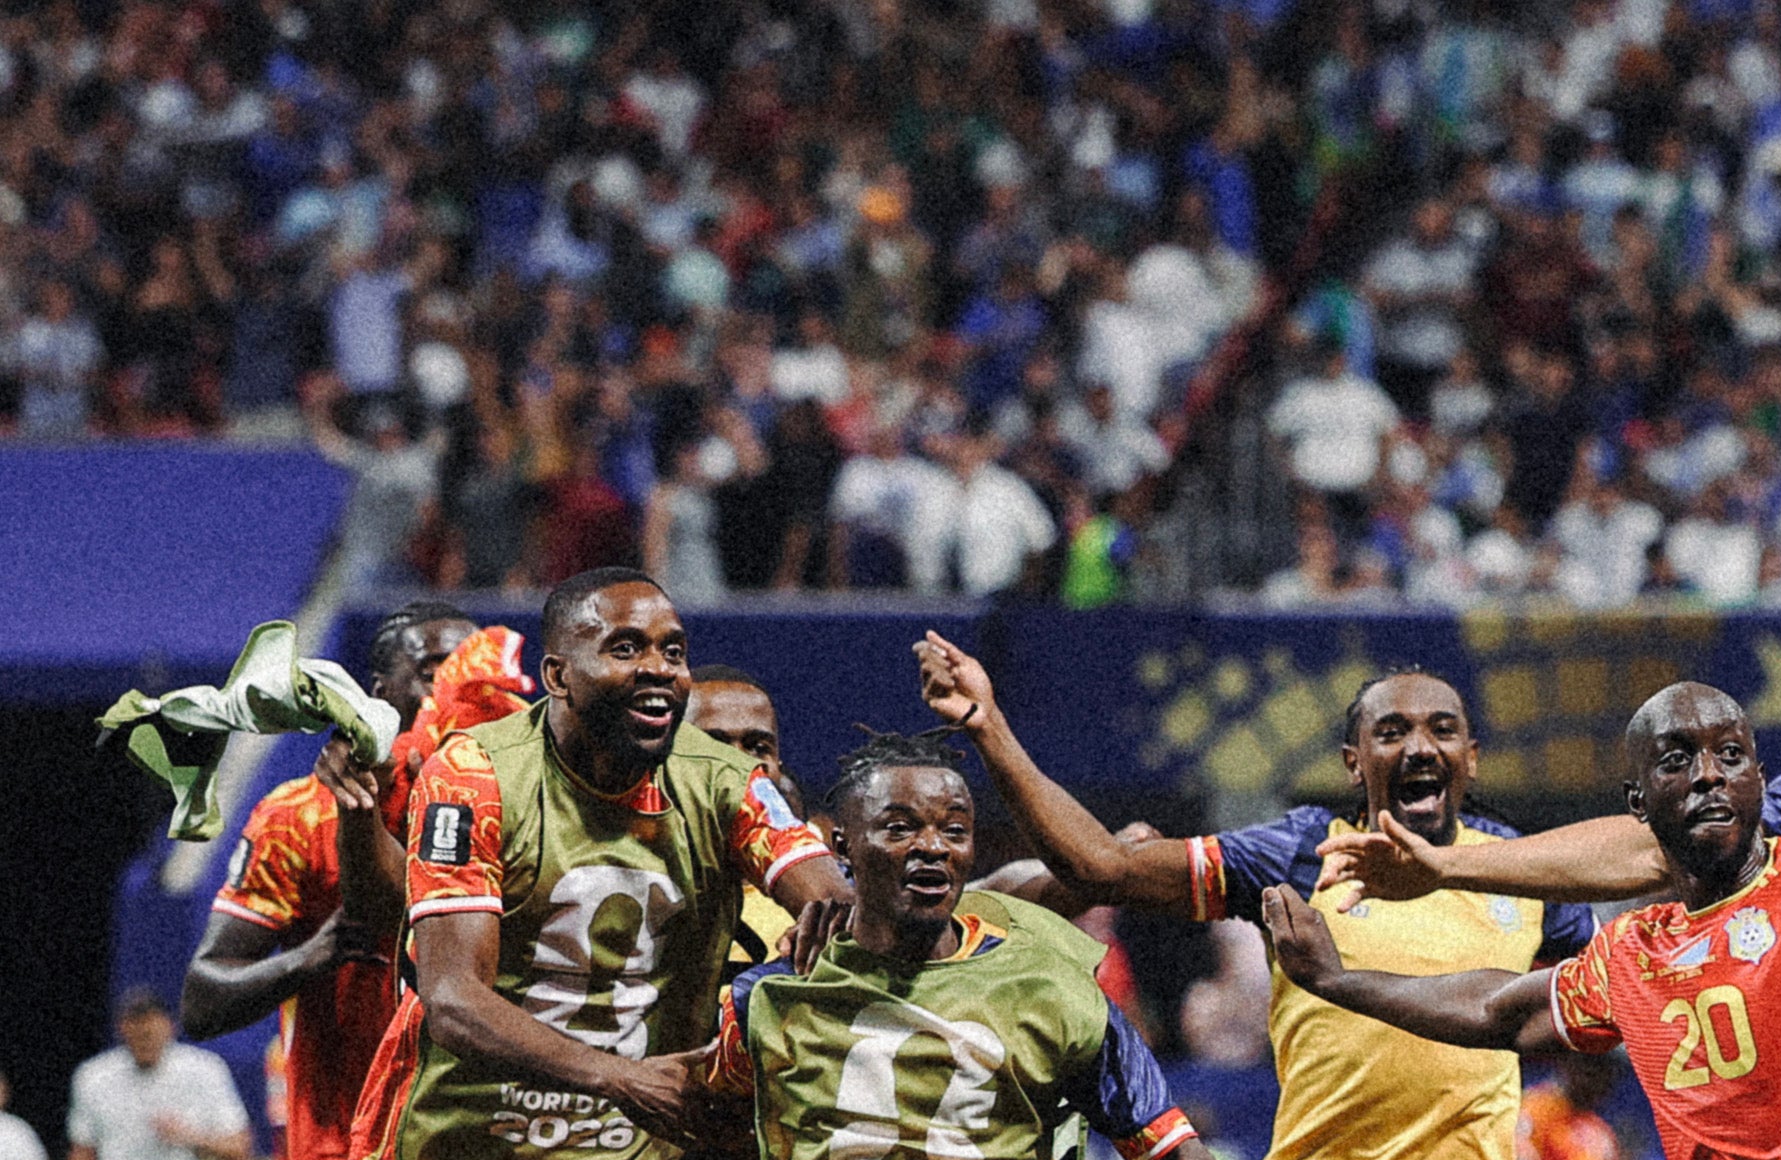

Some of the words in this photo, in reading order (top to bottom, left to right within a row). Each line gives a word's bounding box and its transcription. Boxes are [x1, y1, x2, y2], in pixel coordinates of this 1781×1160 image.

[1659, 985, 1758, 1091] 20
[500, 1084, 594, 1114] WORLD
[490, 1111, 634, 1149] 2026
